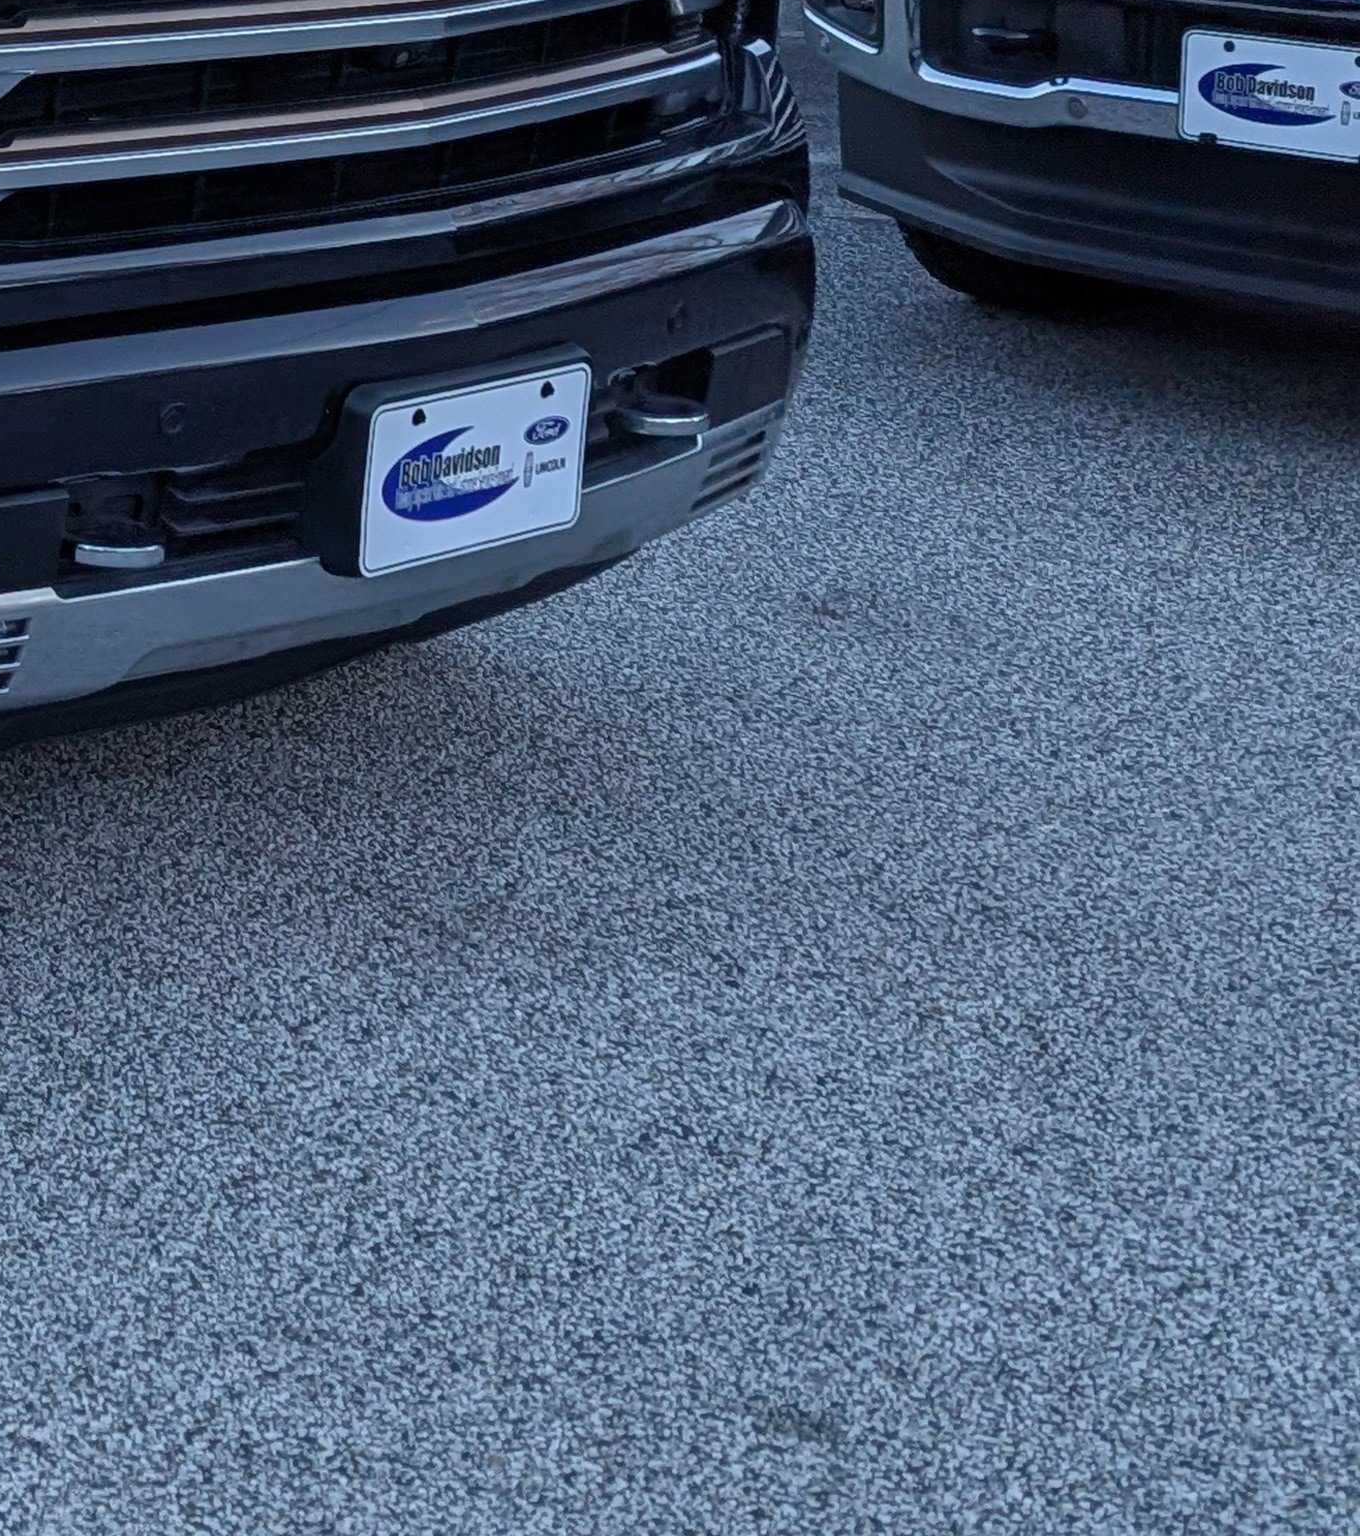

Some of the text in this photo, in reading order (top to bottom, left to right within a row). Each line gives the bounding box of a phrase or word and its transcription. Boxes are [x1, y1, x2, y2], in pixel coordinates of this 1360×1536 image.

[1216, 72, 1315, 101] Bob Davidson
[400, 455, 432, 487] Bob
[433, 444, 501, 480] Davidson
